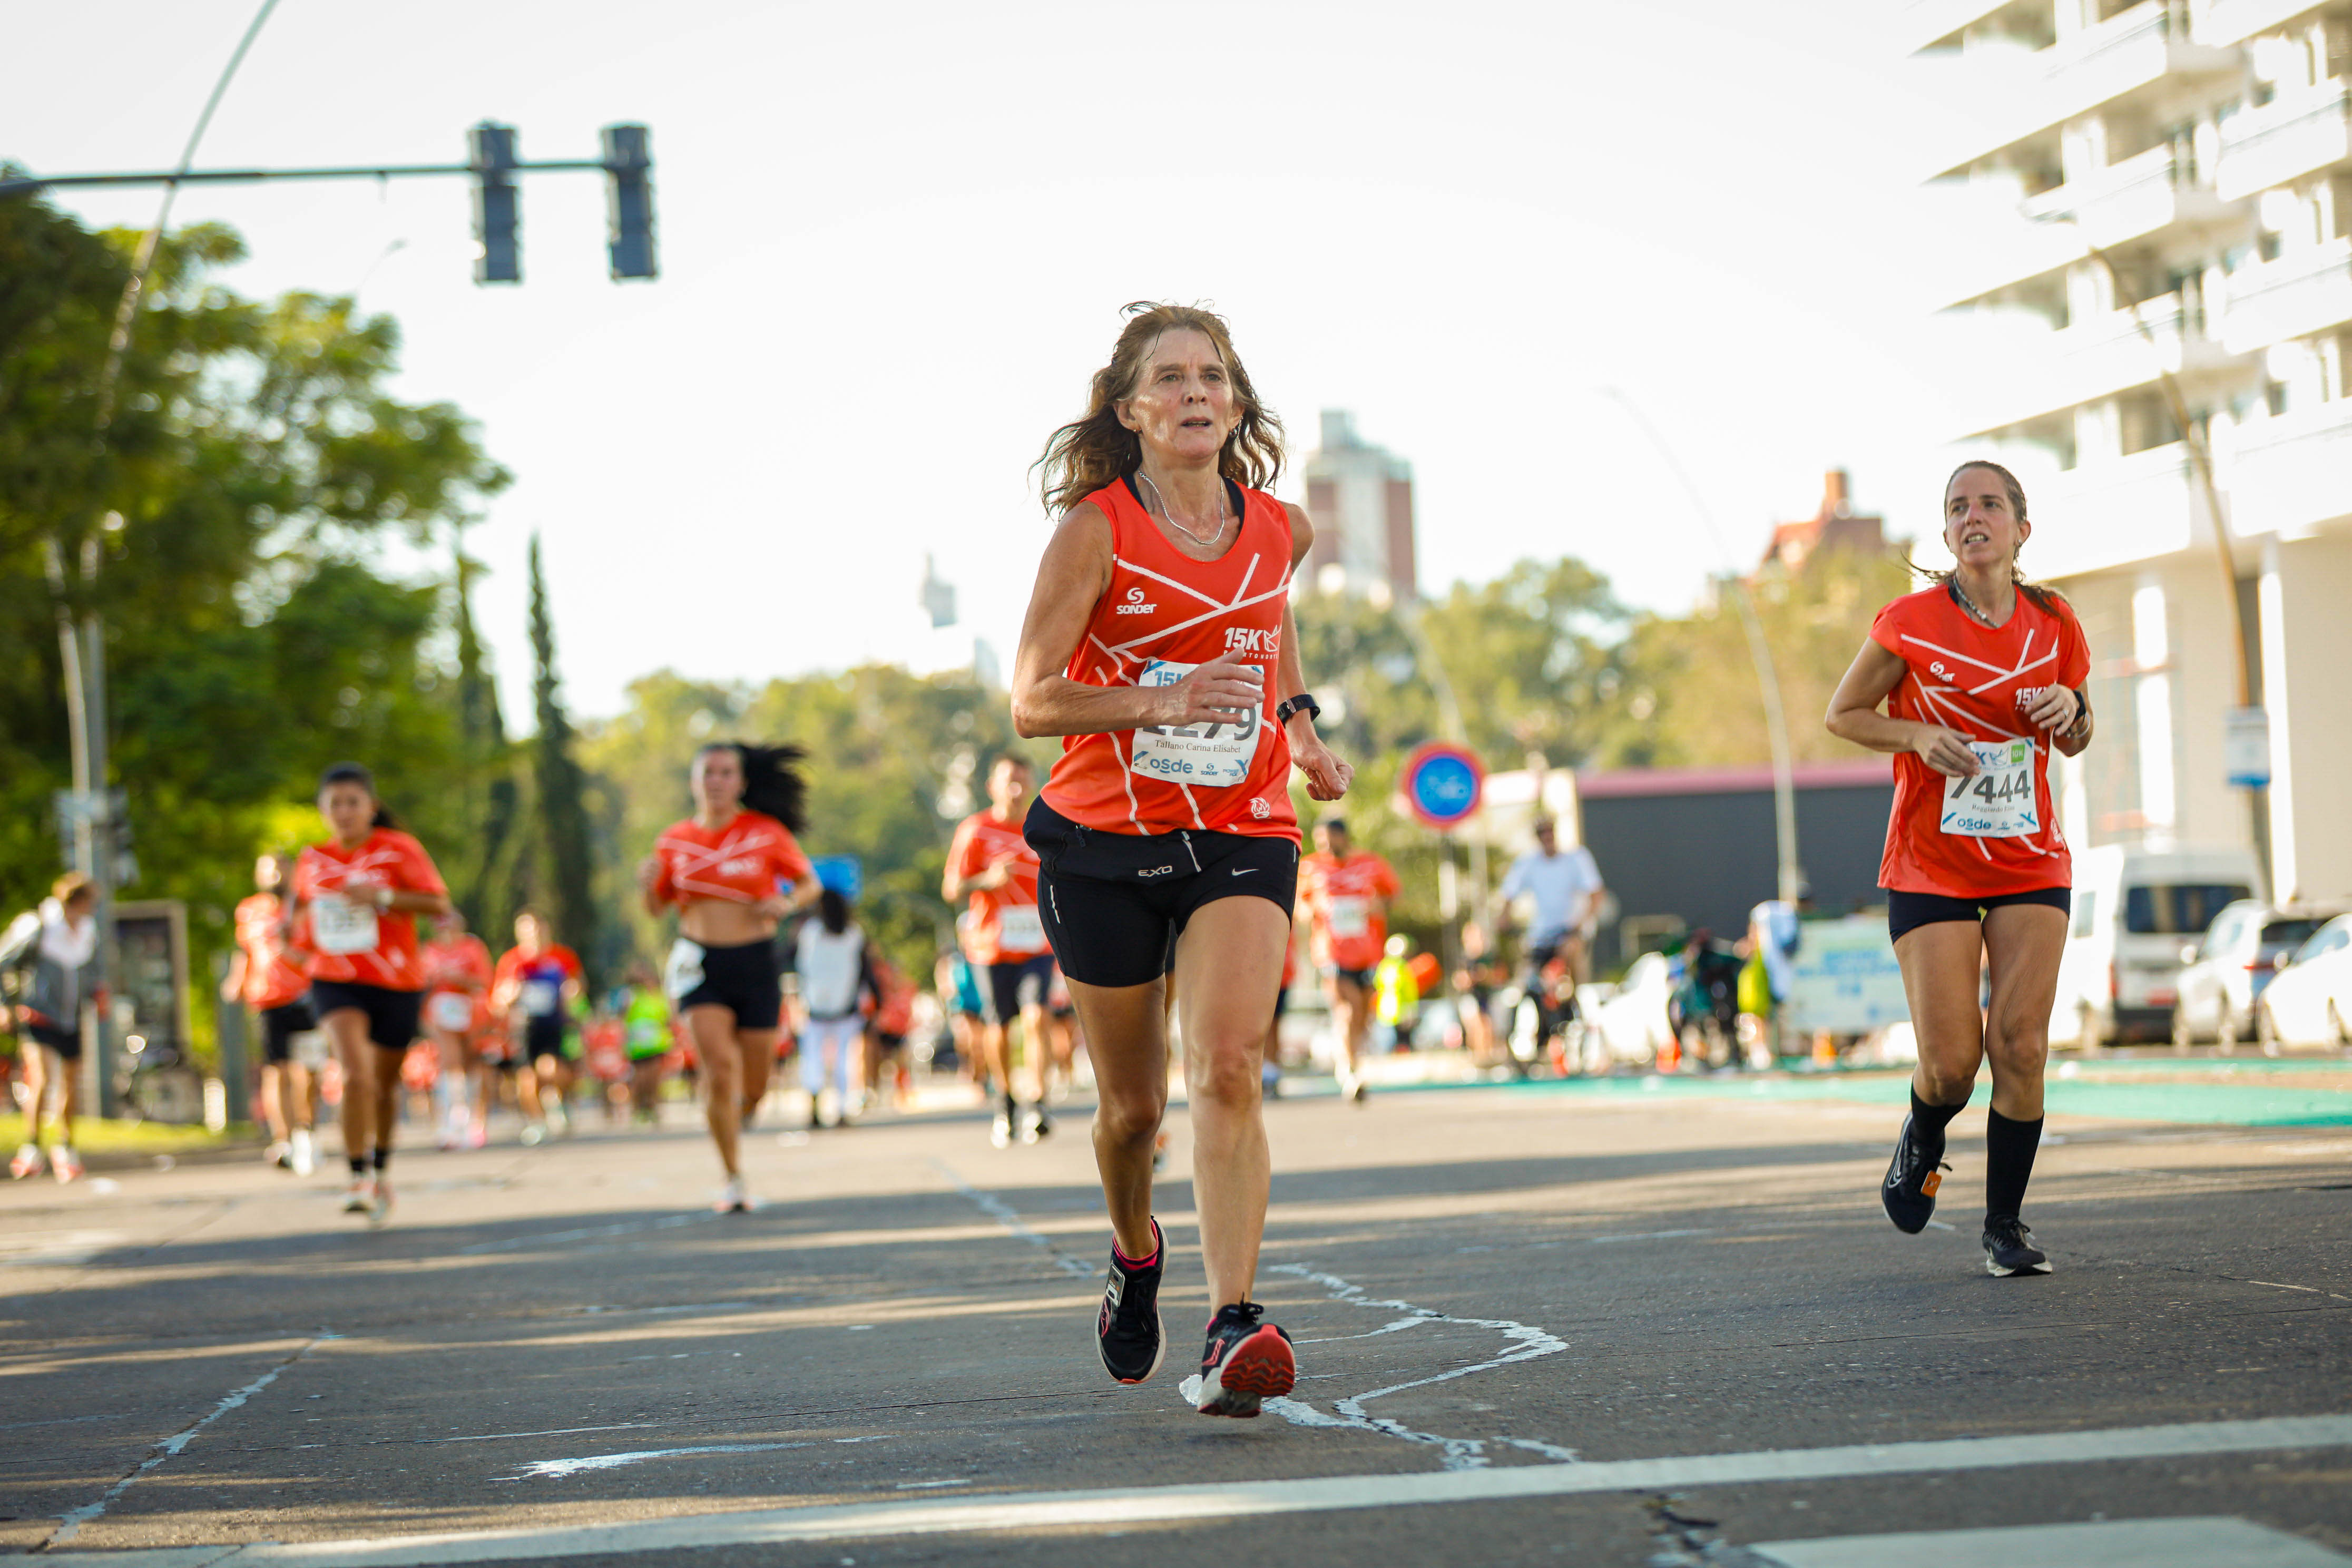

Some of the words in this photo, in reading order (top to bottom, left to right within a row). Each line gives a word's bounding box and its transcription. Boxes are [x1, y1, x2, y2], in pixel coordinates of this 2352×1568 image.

[1225, 627, 1263, 651] 15K
[1155, 739, 1184, 750] Tallano
[1187, 743, 1211, 752] Carina
[1213, 744, 1241, 753] Elisabet
[1150, 758, 1193, 773] osde
[1951, 770, 2031, 804] 7444
[1957, 818, 1992, 830] osde
[1139, 865, 1172, 877] EXO
